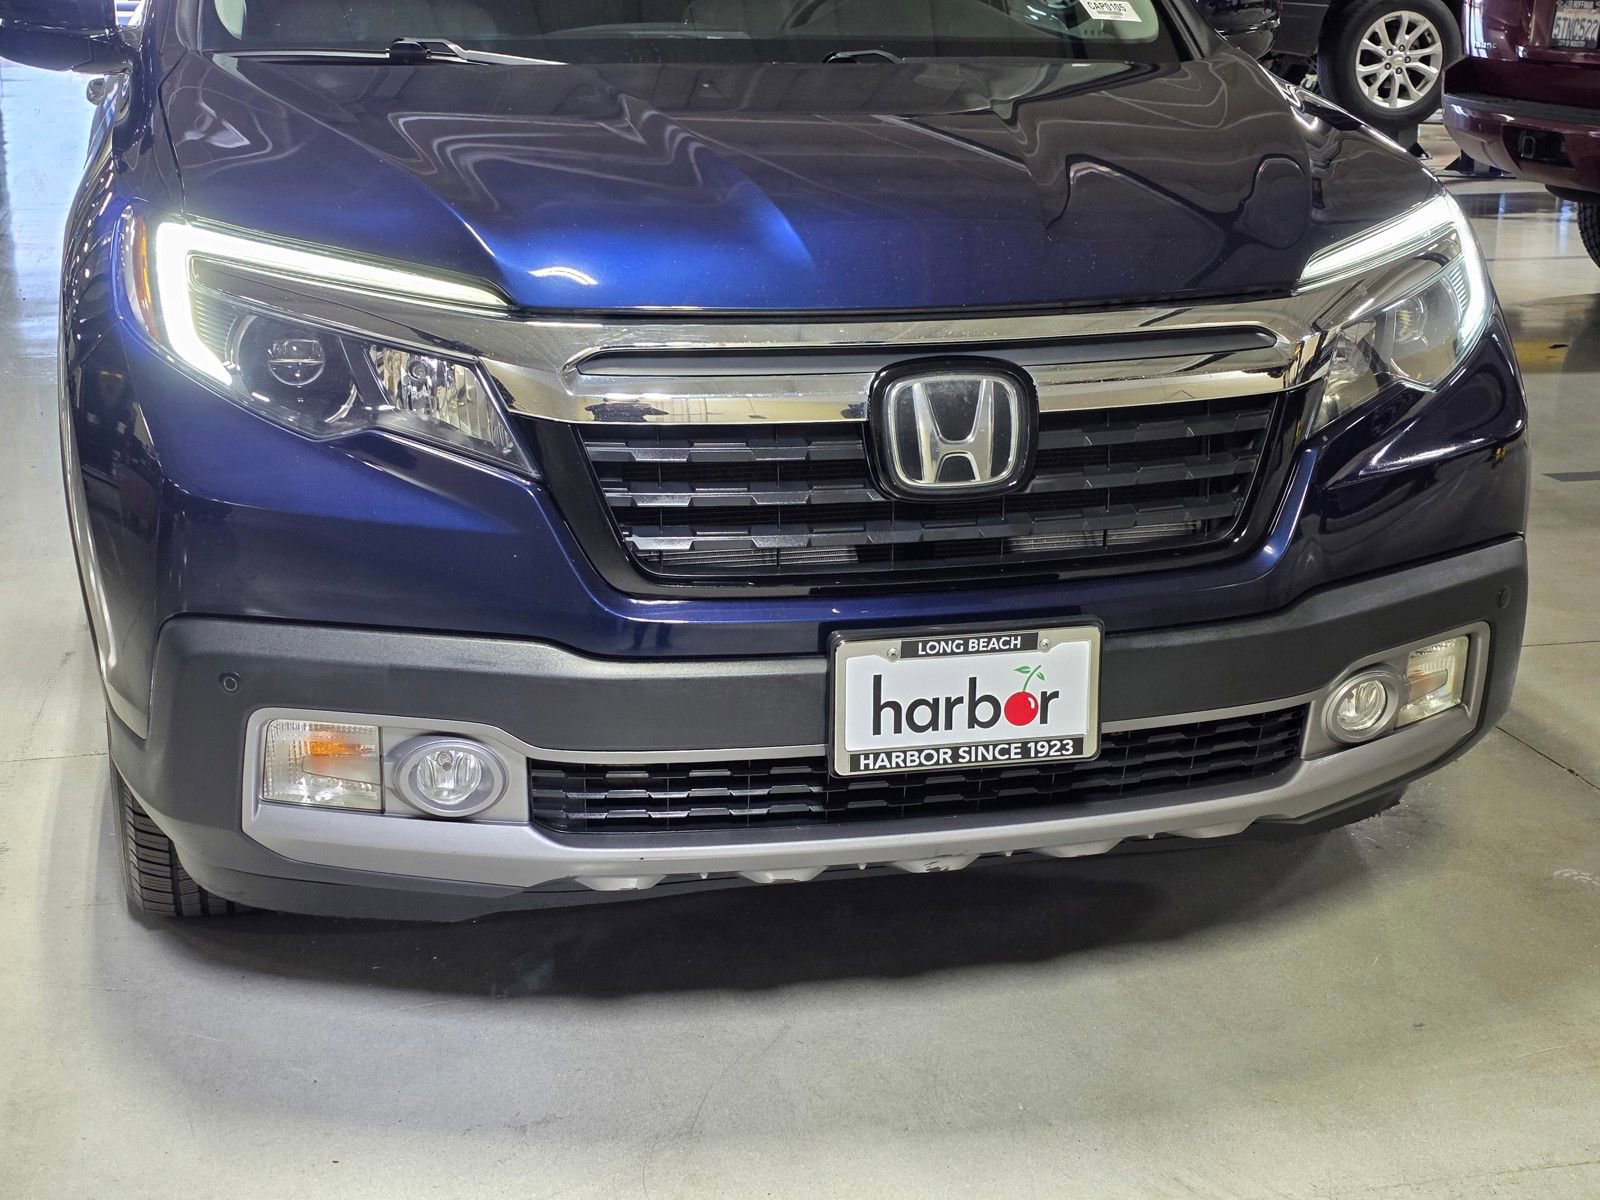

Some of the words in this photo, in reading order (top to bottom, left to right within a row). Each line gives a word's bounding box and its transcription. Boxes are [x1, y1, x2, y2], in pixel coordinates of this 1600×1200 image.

[1087, 2, 1127, 12] CAP0105
[918, 639, 964, 656] LONG
[968, 636, 1022, 652] BEACH
[872, 673, 1060, 736] harbor
[859, 748, 953, 771] HARBOR
[958, 743, 1022, 763] SINCE
[1027, 740, 1074, 758] 1923
